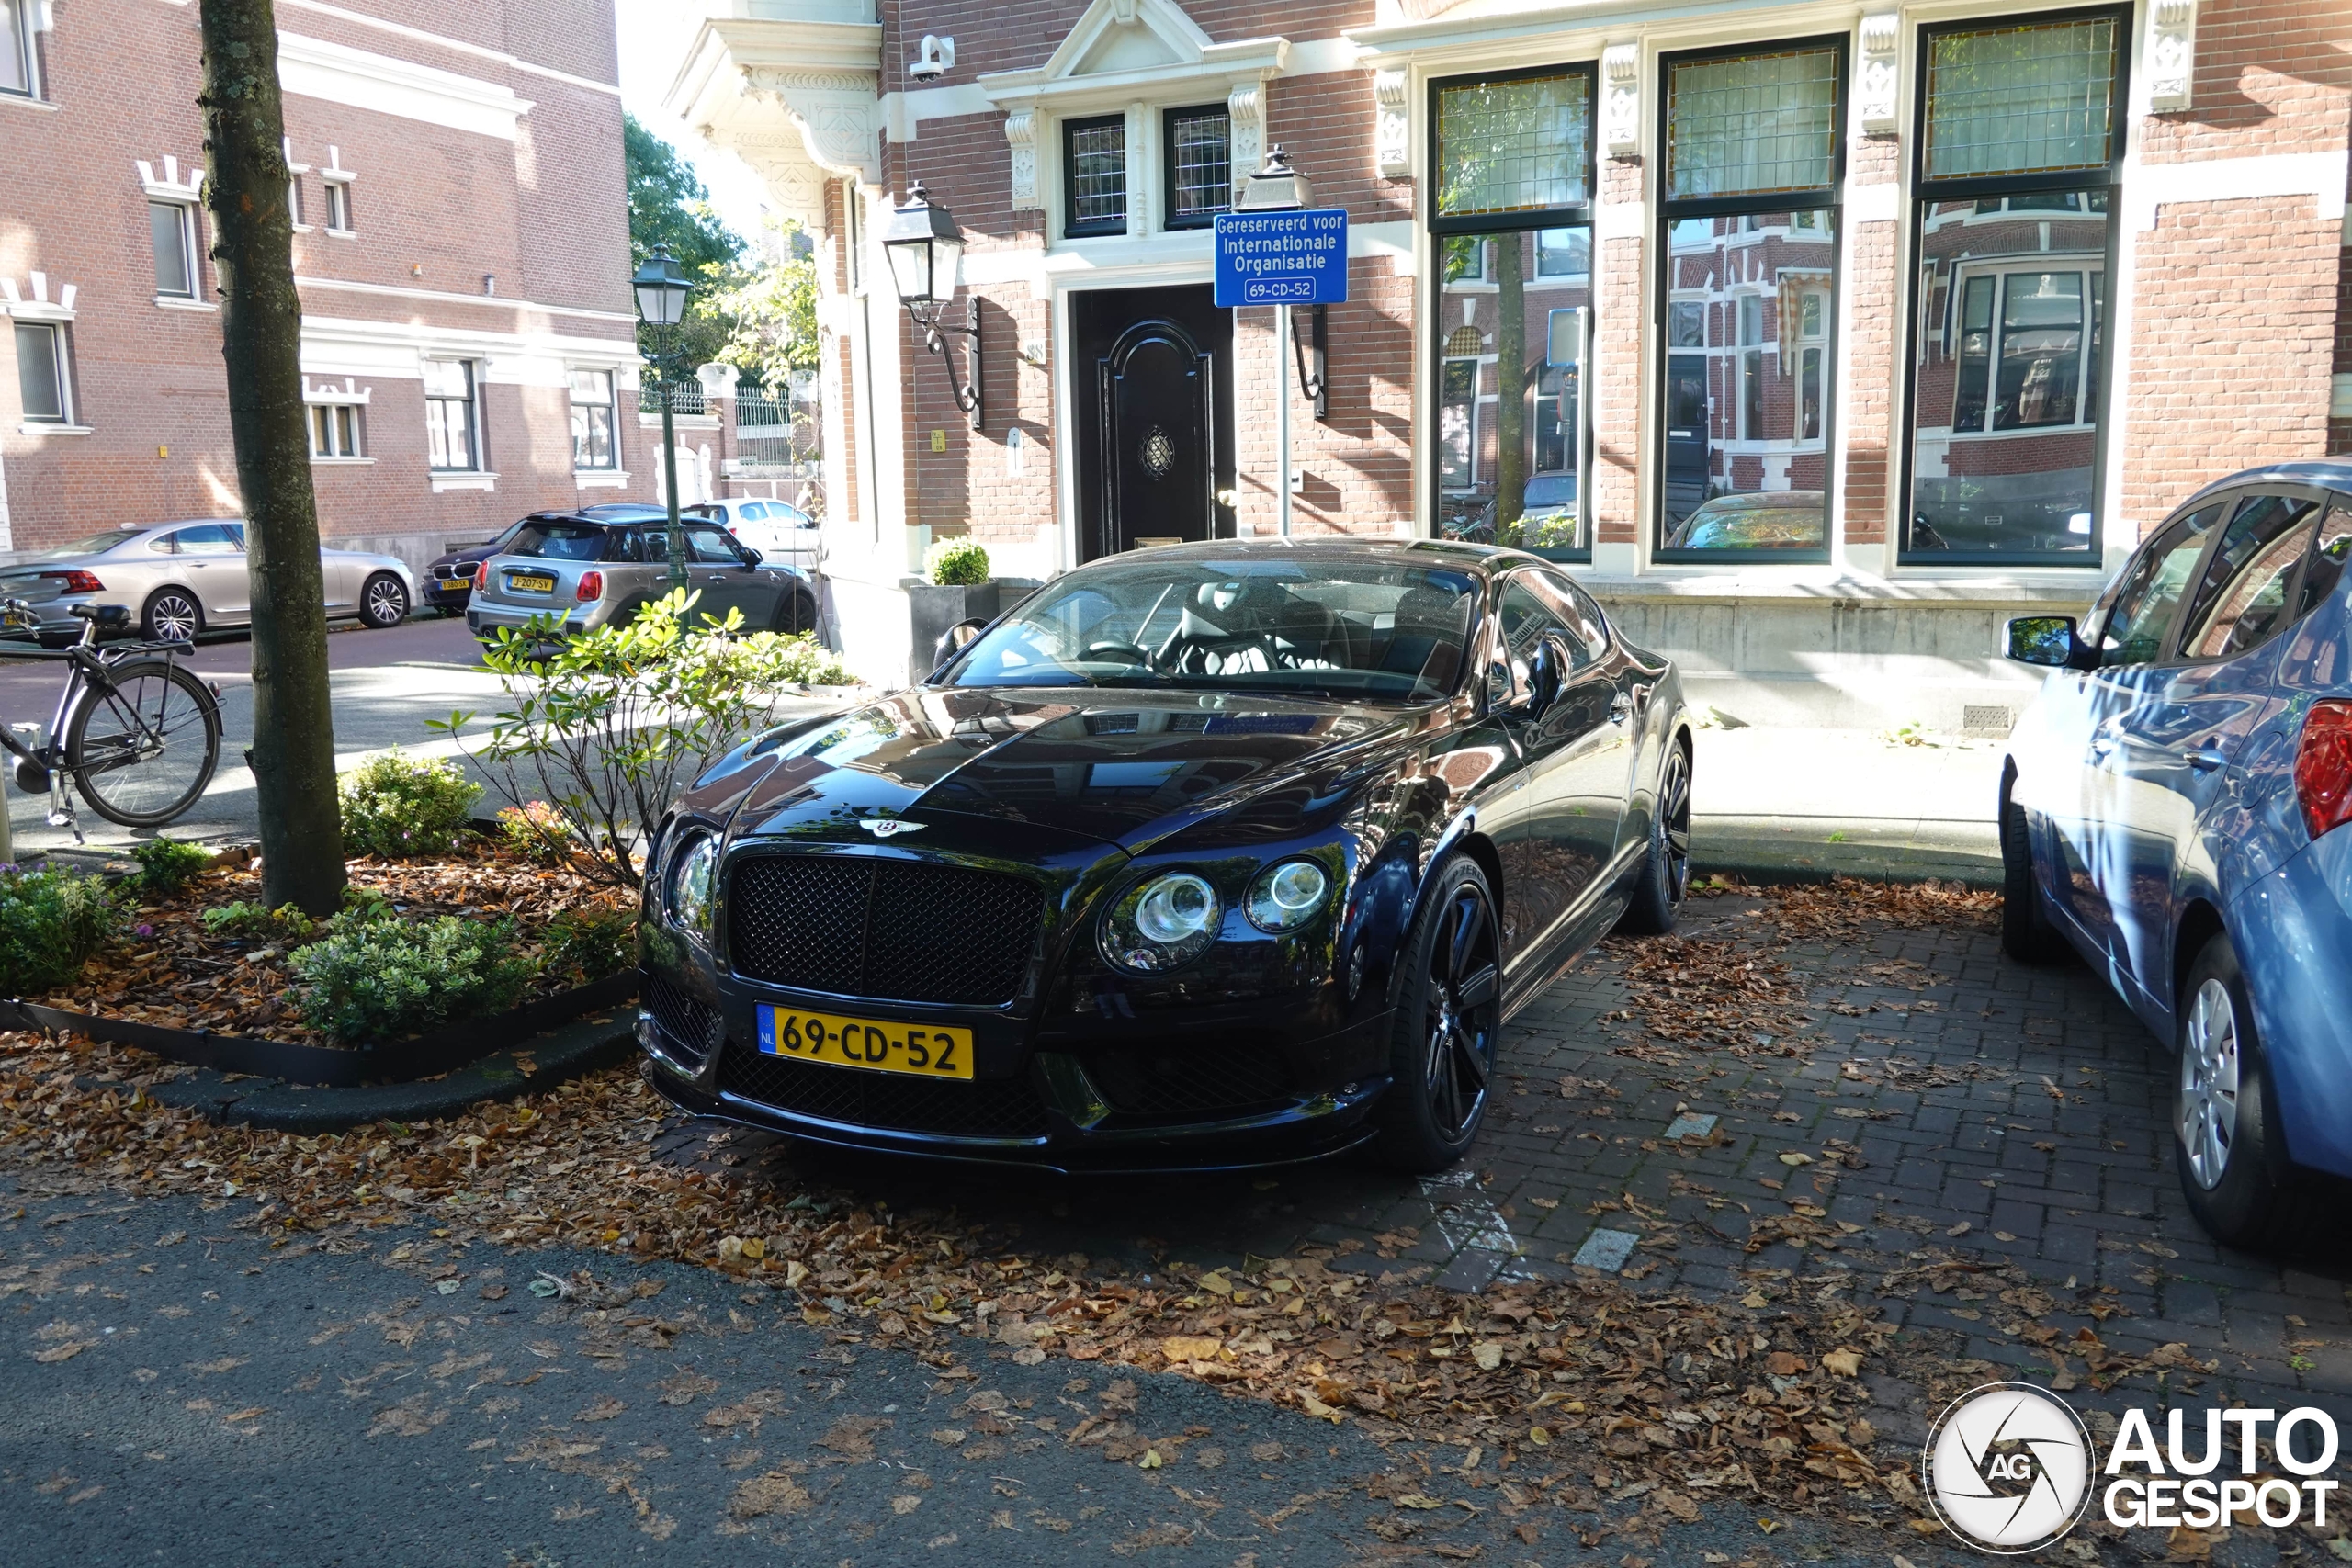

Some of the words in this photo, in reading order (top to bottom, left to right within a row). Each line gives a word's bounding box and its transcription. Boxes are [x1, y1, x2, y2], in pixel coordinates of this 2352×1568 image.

[1217, 214, 1307, 234] Gereserveerd
[1313, 216, 1343, 230] voor
[1224, 233, 1337, 254] Internationale
[1234, 254, 1326, 276] Organisatie
[1250, 282, 1311, 298] 69-CD-52
[514, 577, 549, 589] J-207-SV
[1460, 864, 1484, 882] ZERO
[761, 1032, 774, 1045] NL
[782, 1015, 956, 1070] 69-CD-52
